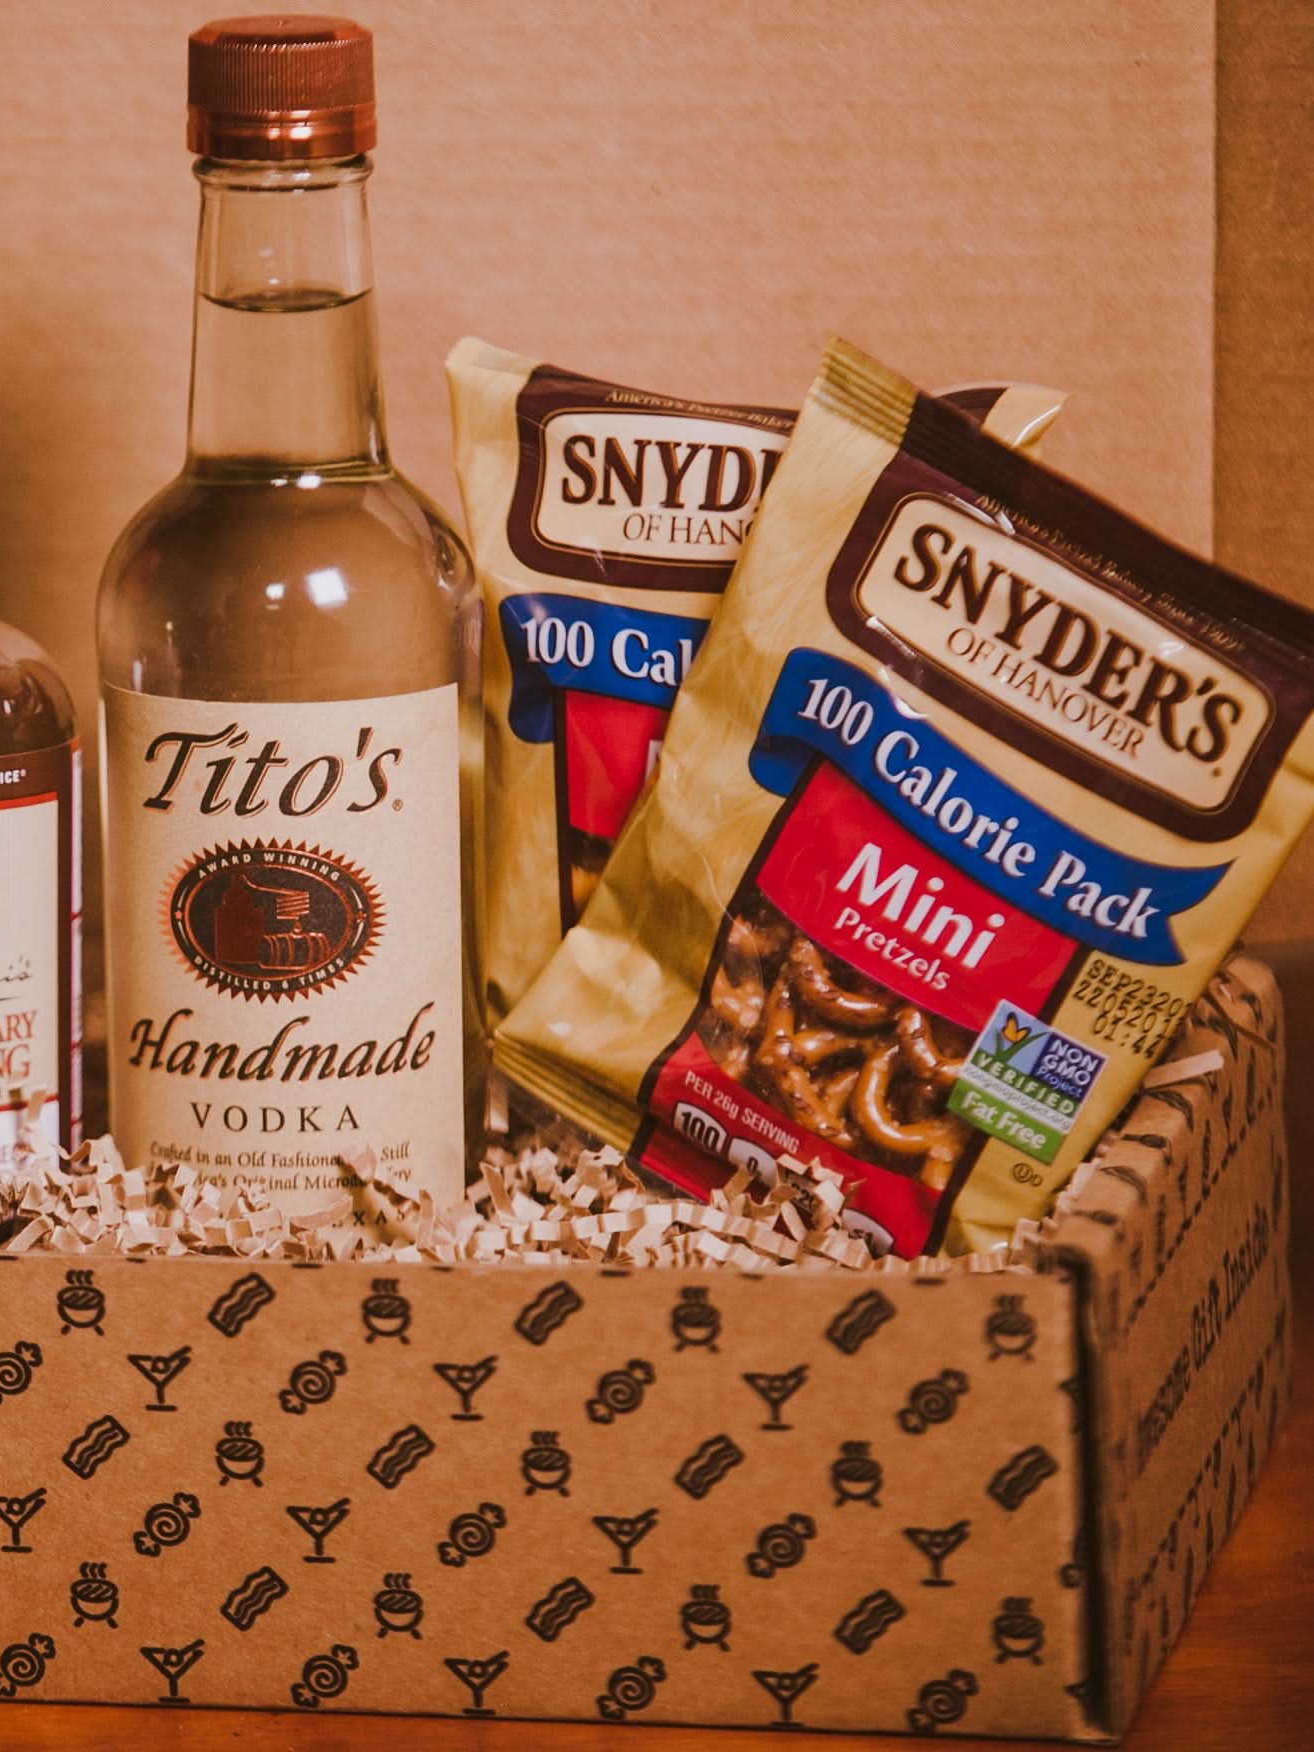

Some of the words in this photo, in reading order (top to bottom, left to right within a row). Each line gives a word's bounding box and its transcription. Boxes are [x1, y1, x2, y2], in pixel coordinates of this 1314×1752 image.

[623, 513, 662, 541] OF
[670, 516, 755, 545] HAN
[520, 617, 595, 668] 100
[893, 524, 1243, 763] SNYDER'S
[946, 627, 1000, 664] OF
[992, 655, 1146, 758] HANOVER
[142, 722, 403, 818] Tito's
[797, 679, 874, 745] 100
[875, 730, 1037, 877] Calorie
[1039, 850, 1160, 939] Pack
[198, 853, 252, 879] AWARD
[263, 852, 341, 882] WINNING
[836, 841, 1005, 969] Mini
[194, 955, 271, 990] DISTILLED
[281, 980, 289, 990] 6
[298, 957, 346, 986] TIMES
[834, 907, 950, 992] Pretzels
[127, 1001, 437, 1083] Handmade
[1051, 1038, 1098, 1071] NON
[976, 1054, 1075, 1115] VERIFIED
[1036, 1068, 1083, 1098] Project
[1041, 1054, 1091, 1086] GMO
[190, 1102, 361, 1133] VODKA
[680, 1110, 721, 1151] 100
[685, 1069, 713, 1098] PER
[713, 1091, 739, 1119] 26g
[741, 1107, 800, 1155] SERVING
[962, 1090, 999, 1125] Fat
[997, 1110, 1047, 1149] Free
[196, 1147, 210, 1165] in
[214, 1152, 232, 1166] an
[237, 1150, 266, 1168] Old
[380, 1140, 411, 1161] Still
